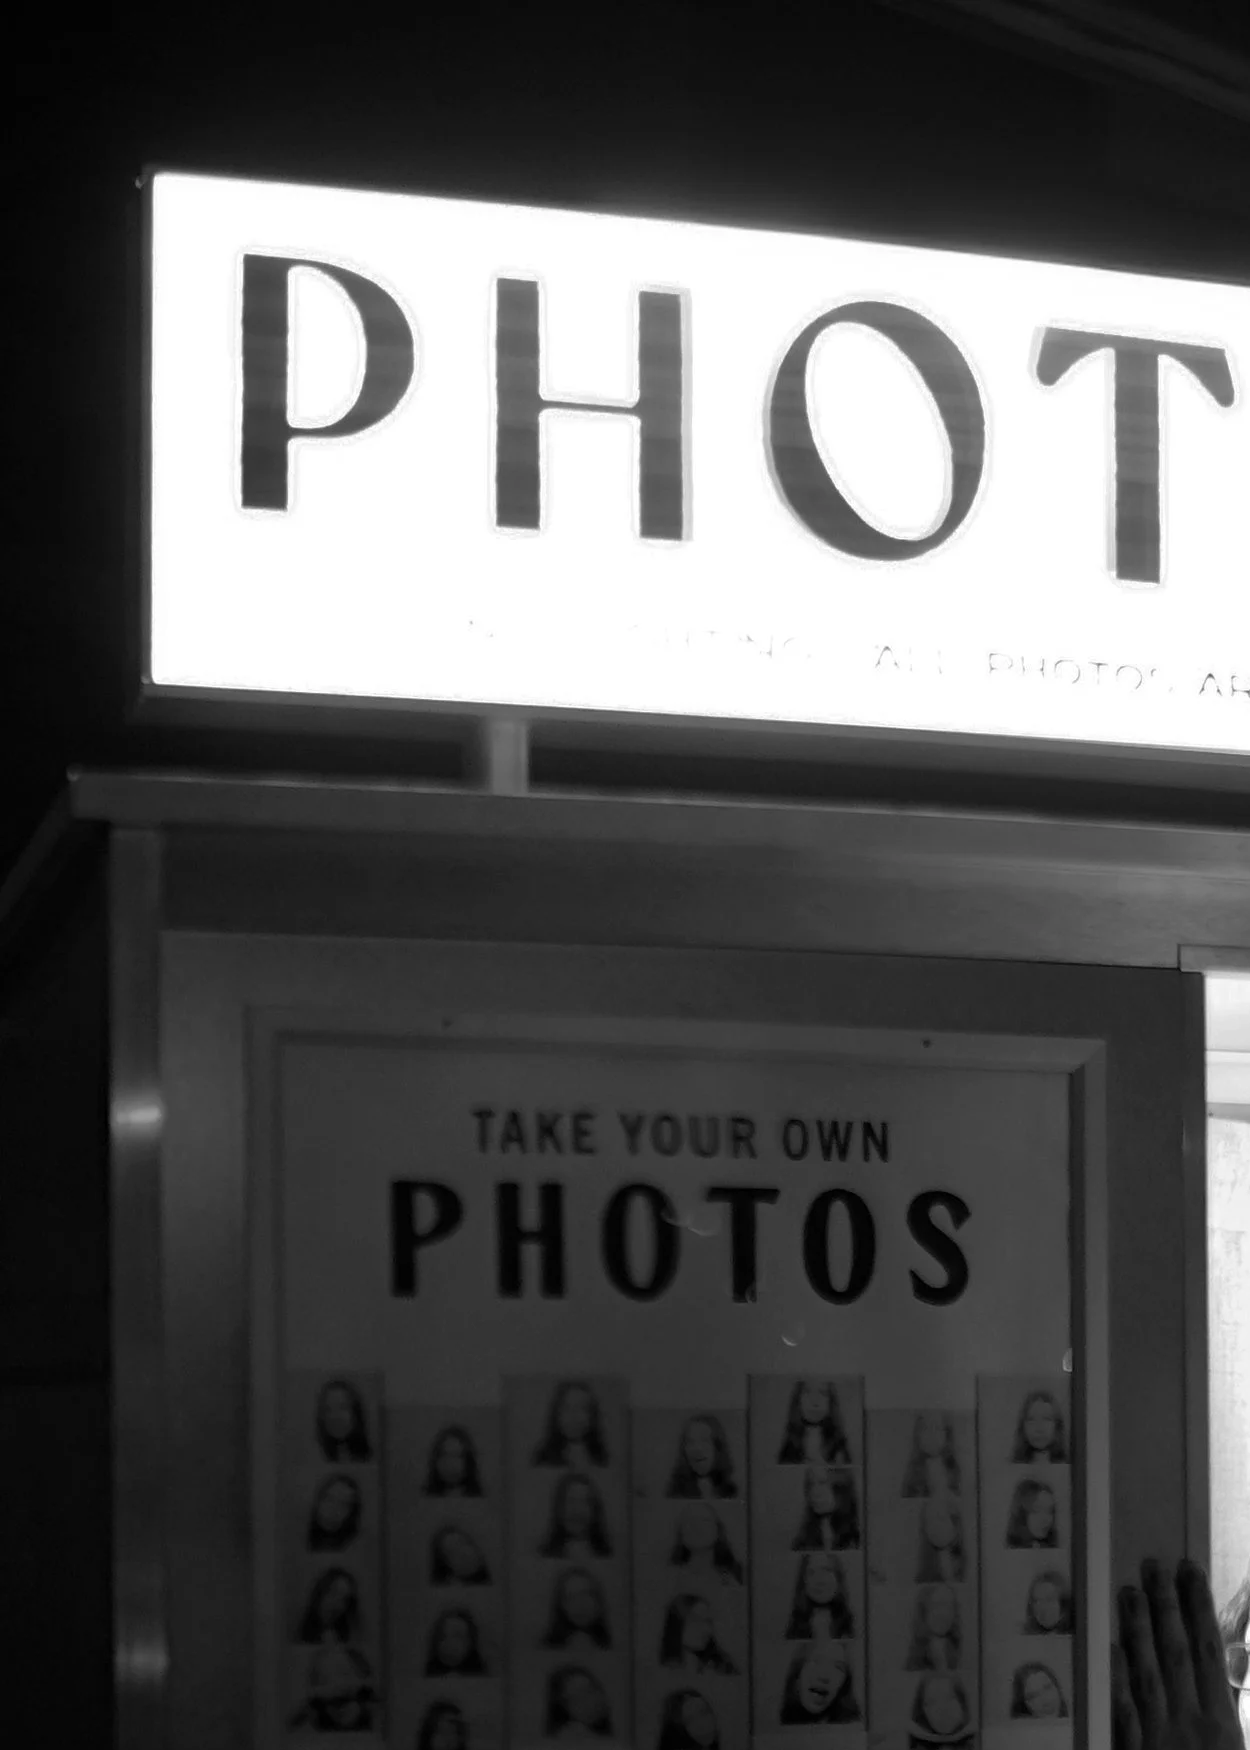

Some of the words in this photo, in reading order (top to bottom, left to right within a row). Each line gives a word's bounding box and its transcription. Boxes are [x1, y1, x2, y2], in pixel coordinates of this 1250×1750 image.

[473, 1107, 598, 1155] TAKE
[618, 1111, 758, 1159] YOUR
[782, 1117, 892, 1164] OWN
[389, 1177, 972, 1306] PHOTOS
